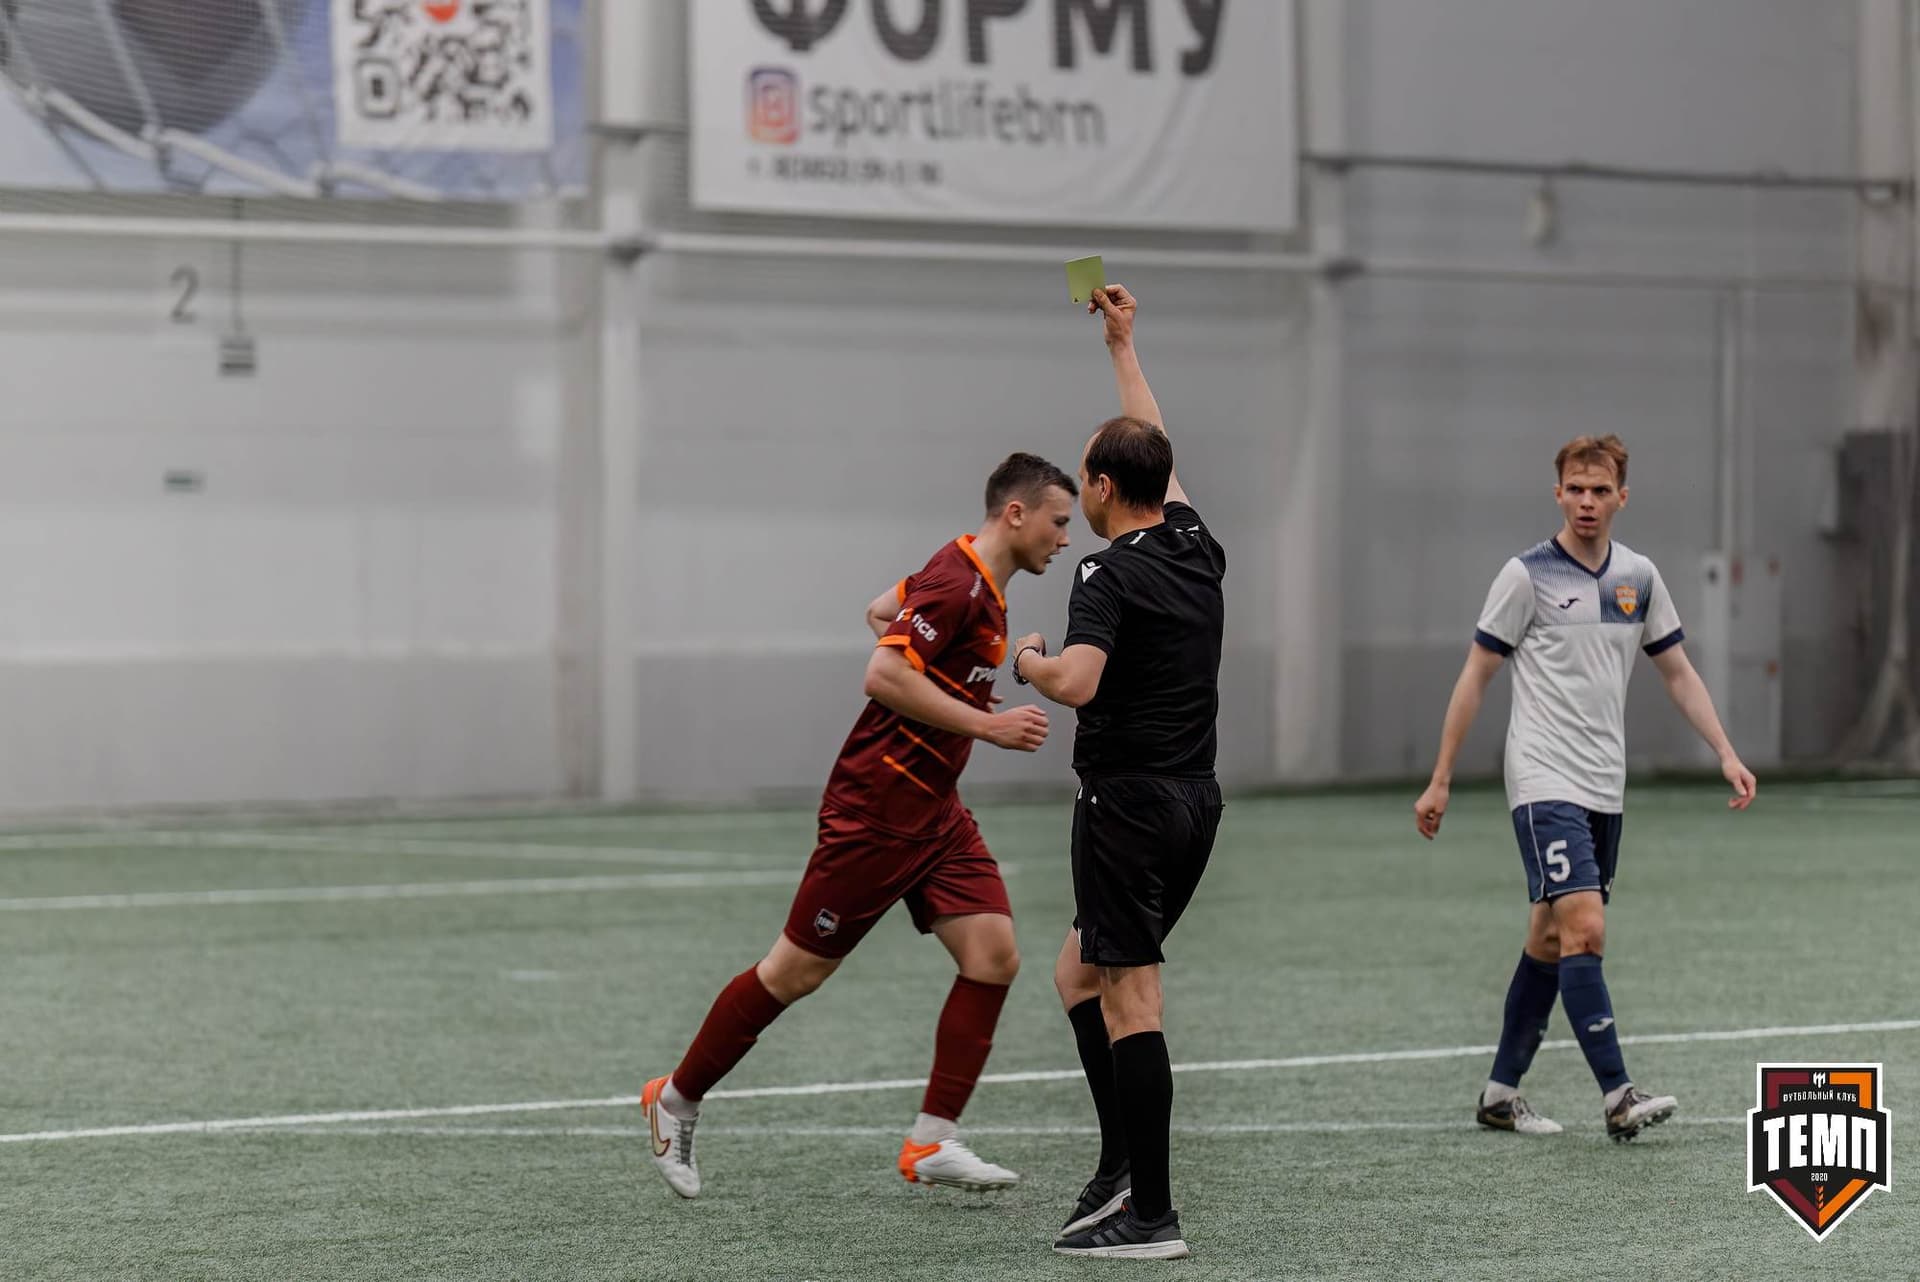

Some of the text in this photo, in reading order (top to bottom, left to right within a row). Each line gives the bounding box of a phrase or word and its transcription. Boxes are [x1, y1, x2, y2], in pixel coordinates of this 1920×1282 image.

[169, 265, 199, 324] 2
[911, 613, 938, 641] ПСБ
[1546, 839, 1571, 882] 5
